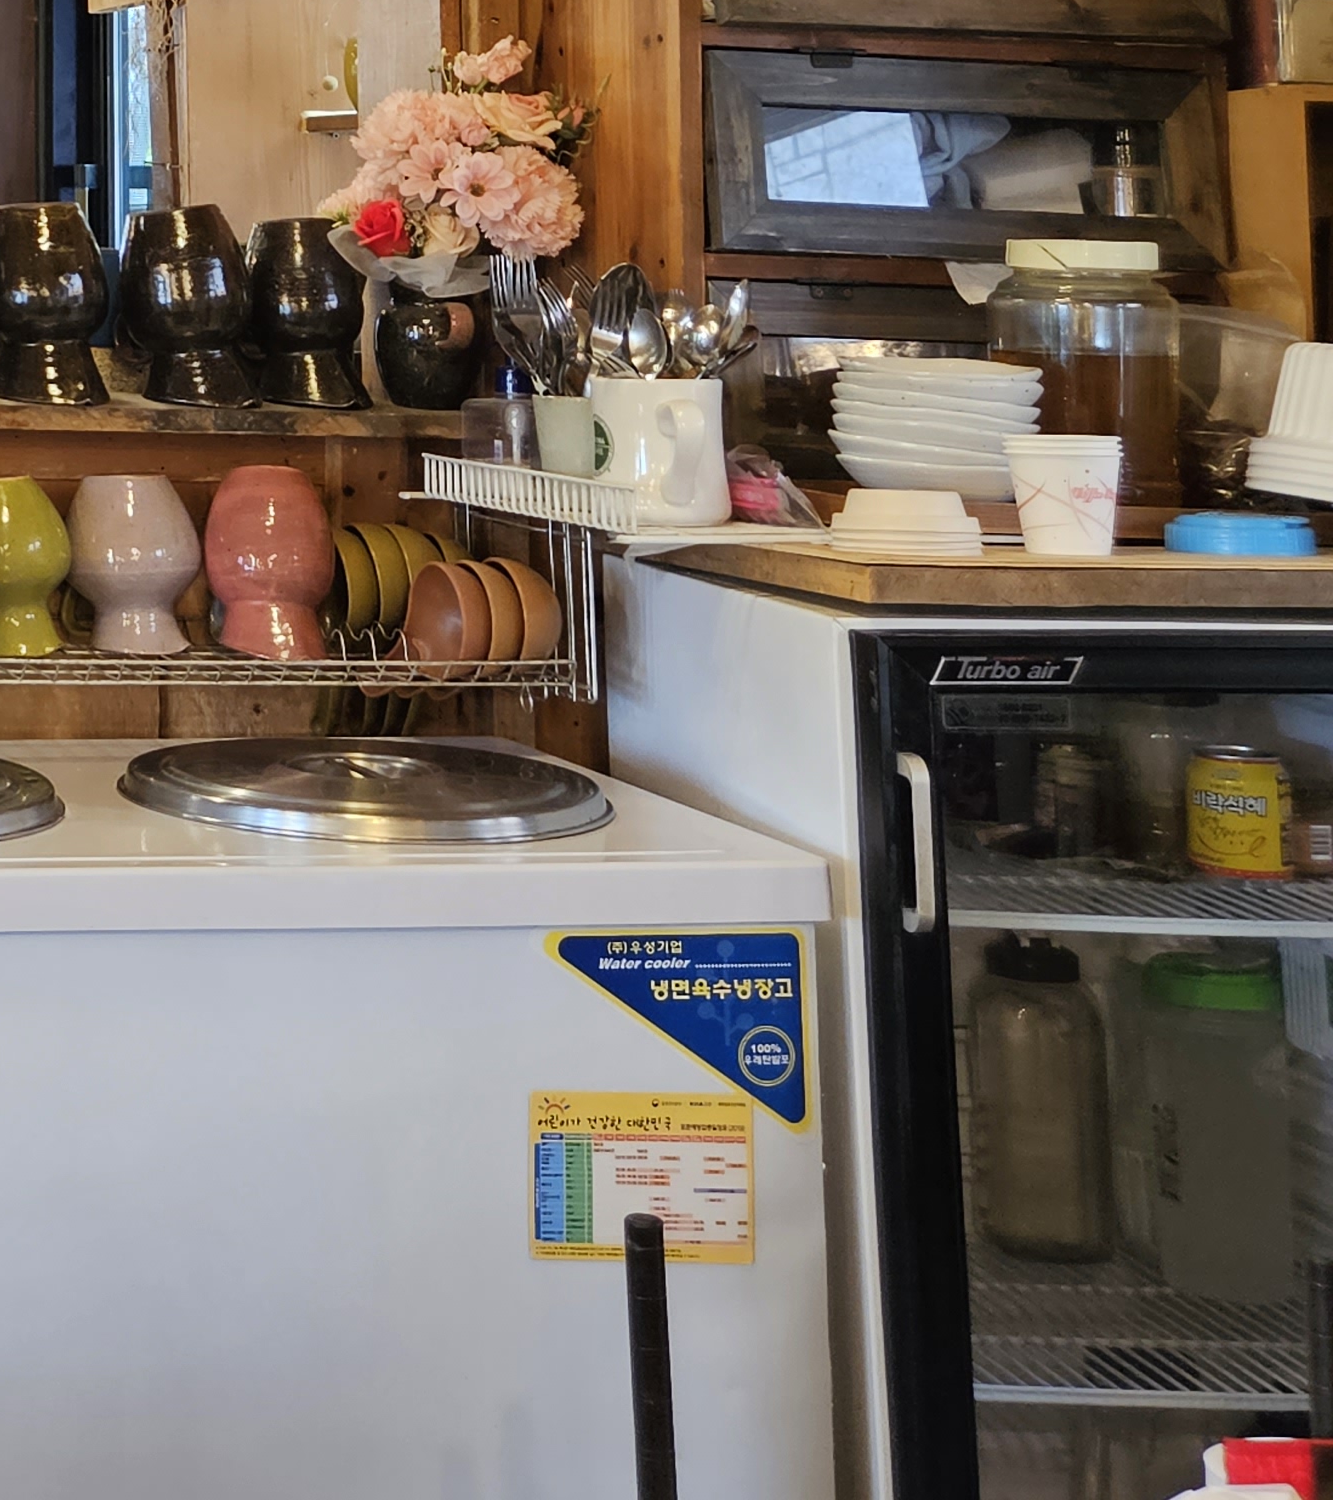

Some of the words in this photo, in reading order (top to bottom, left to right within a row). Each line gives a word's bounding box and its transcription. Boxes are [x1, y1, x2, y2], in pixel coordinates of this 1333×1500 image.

[957, 656, 1021, 679] Turbo
[1027, 661, 1060, 679] air
[1193, 789, 1267, 817] 비락식혜
[599, 958, 642, 970] Water
[644, 957, 691, 970] cooler
[650, 978, 793, 1001] 냉면육수냉장고
[751, 1044, 782, 1054] 100%
[538, 1115, 581, 1128] 어린이가
[587, 1115, 621, 1131] 건강한
[626, 1116, 672, 1131] 대한민국
